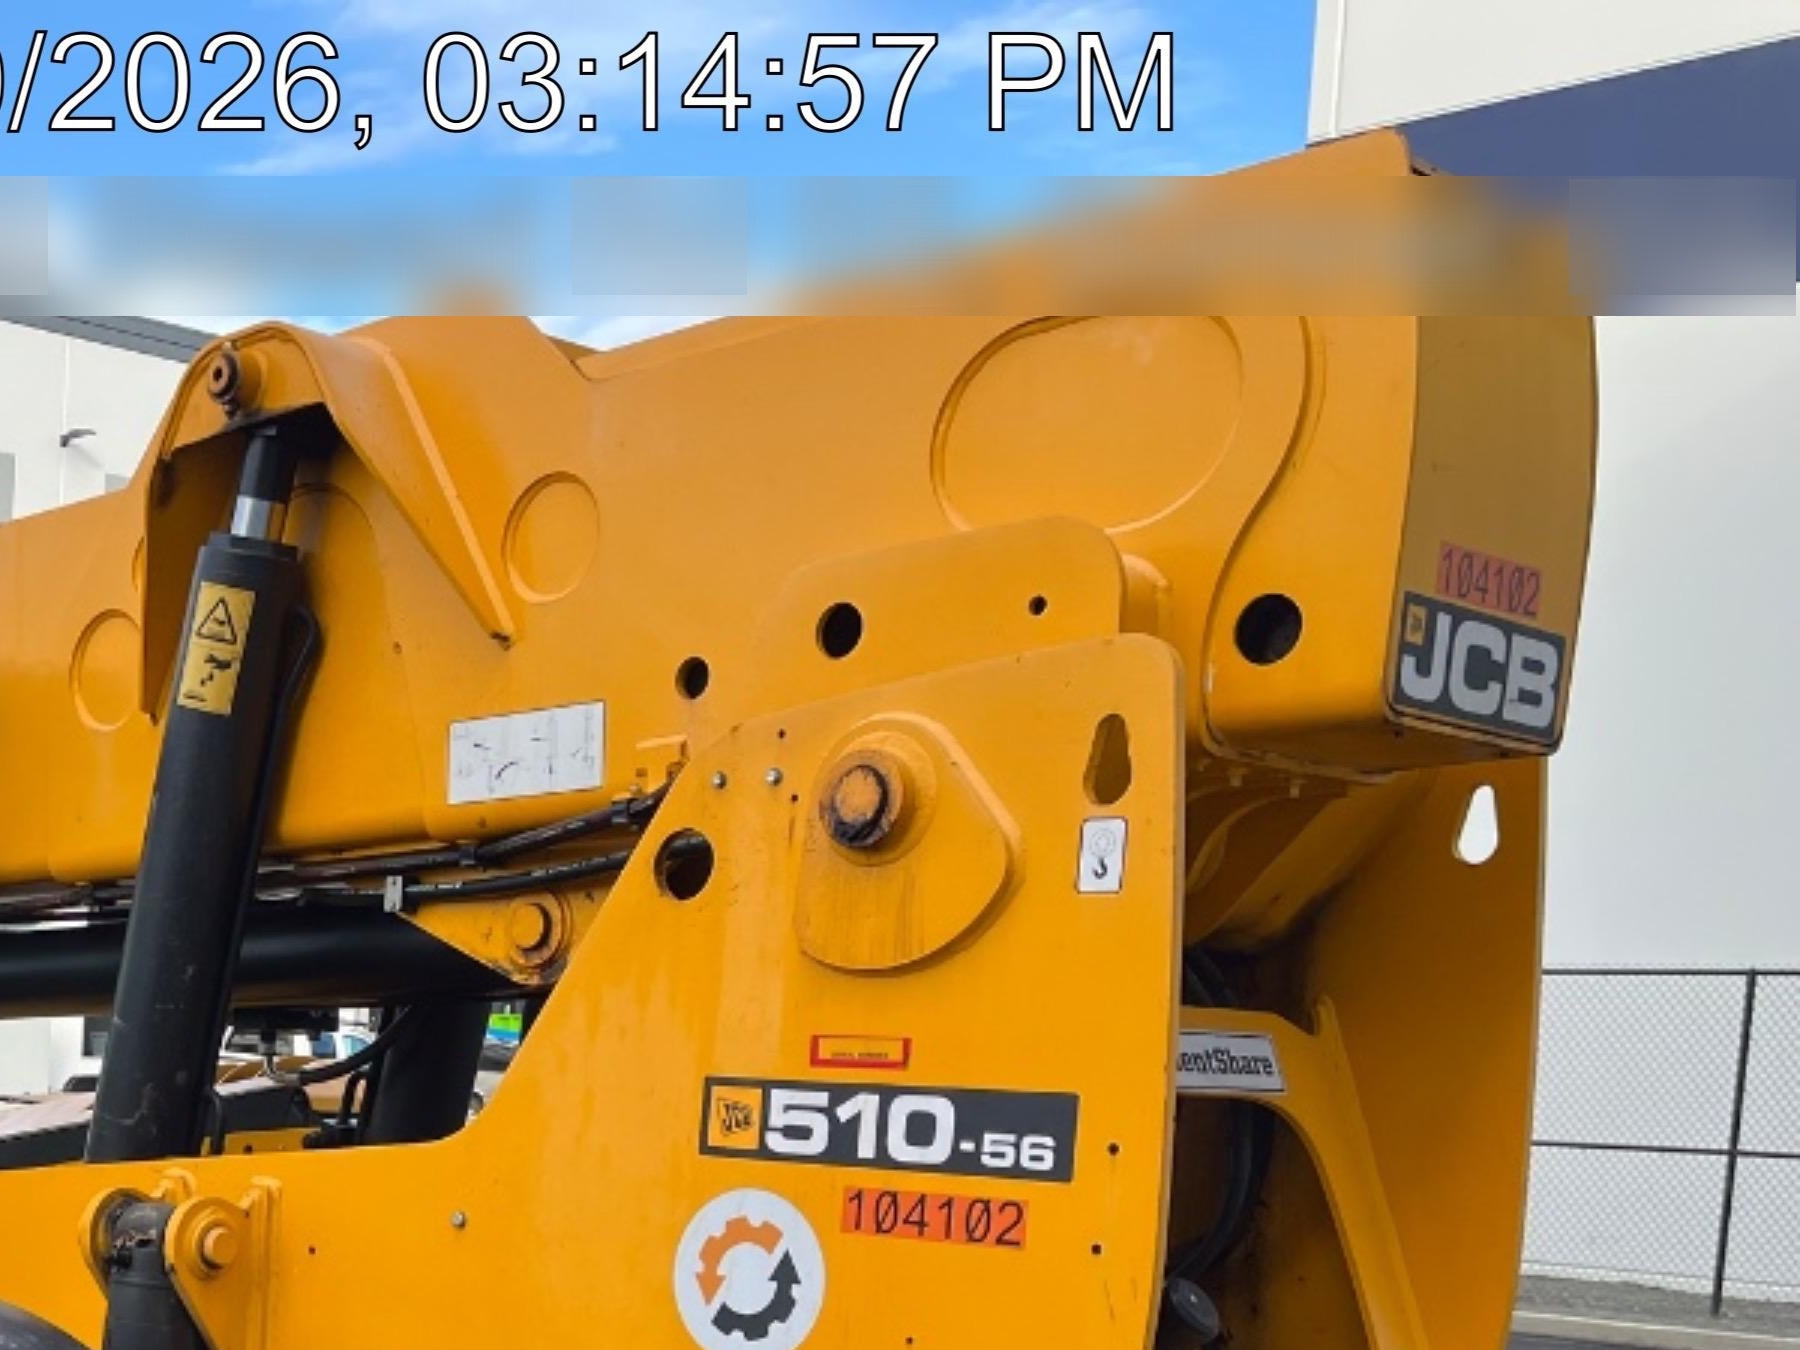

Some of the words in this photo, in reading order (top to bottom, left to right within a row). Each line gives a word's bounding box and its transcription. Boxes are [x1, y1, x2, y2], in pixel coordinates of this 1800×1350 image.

[1441, 547, 1542, 617] 104102
[1400, 611, 1559, 728] JCB
[764, 1087, 1057, 1172] 510-56
[847, 1190, 1026, 1247] 104102
